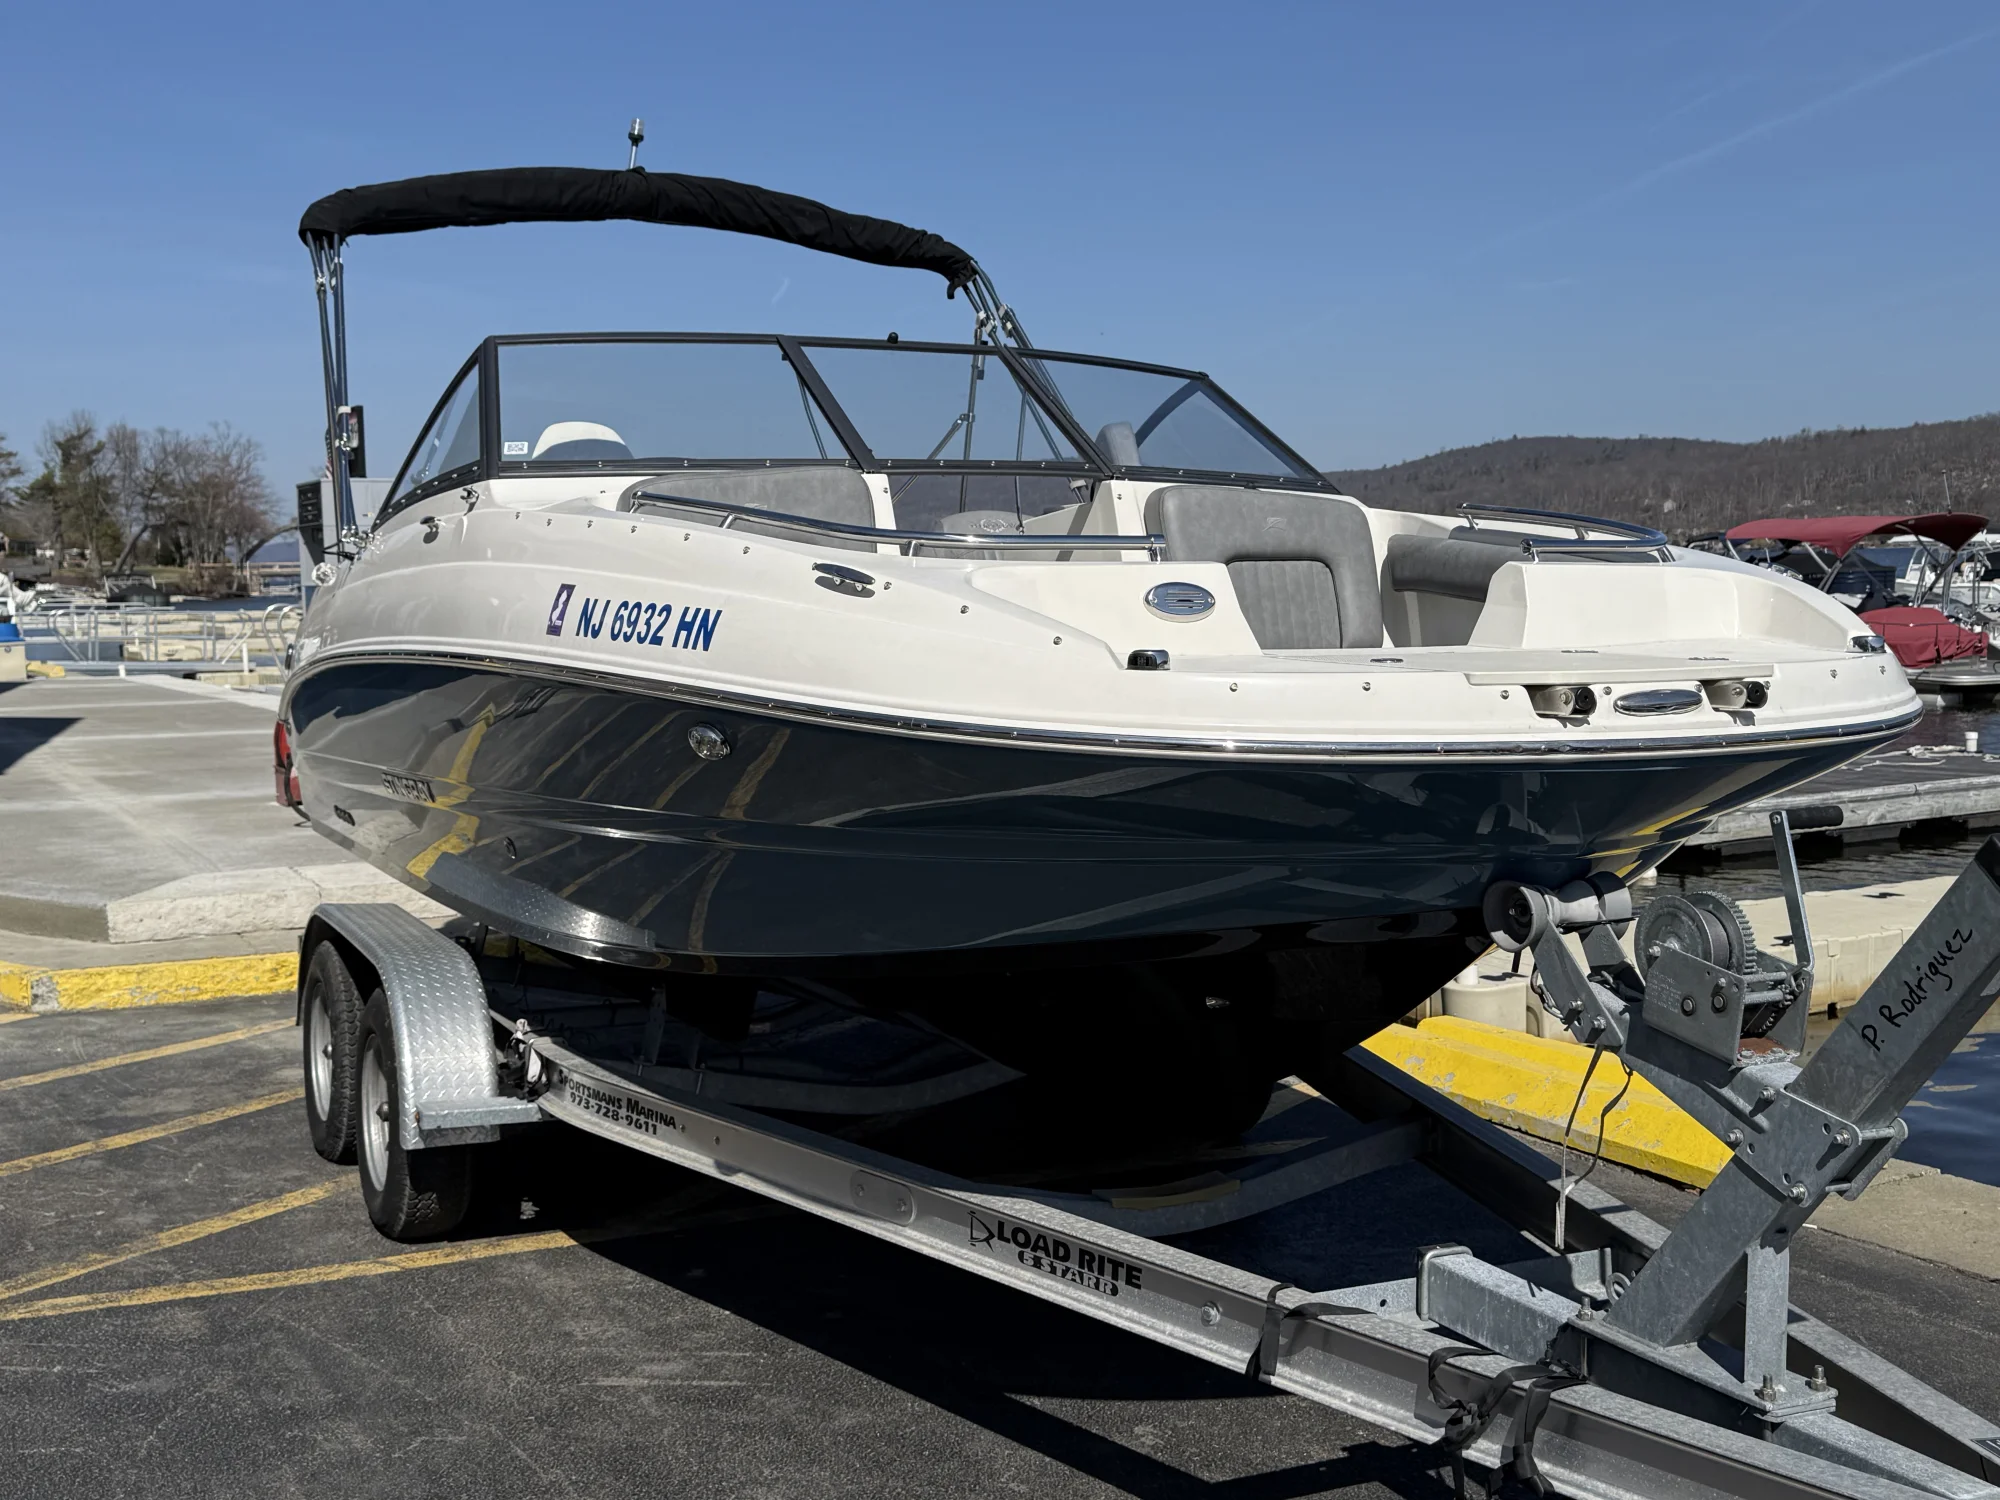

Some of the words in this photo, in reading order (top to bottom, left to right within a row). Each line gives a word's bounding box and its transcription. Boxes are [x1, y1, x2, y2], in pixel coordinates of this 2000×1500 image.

[575, 597, 611, 640] NJ
[610, 600, 673, 647] 6932
[672, 606, 723, 652] HN
[1861, 1024, 1885, 1052] P.
[1878, 928, 1973, 1028] Rodriguez
[558, 1068, 623, 1111] SPORTSMANS
[626, 1097, 677, 1130] MARINA
[569, 1091, 658, 1136] 973-728-9611
[997, 1219, 1071, 1263] LOAD
[1078, 1247, 1143, 1290] RITE
[1039, 1257, 1113, 1296] STARR
